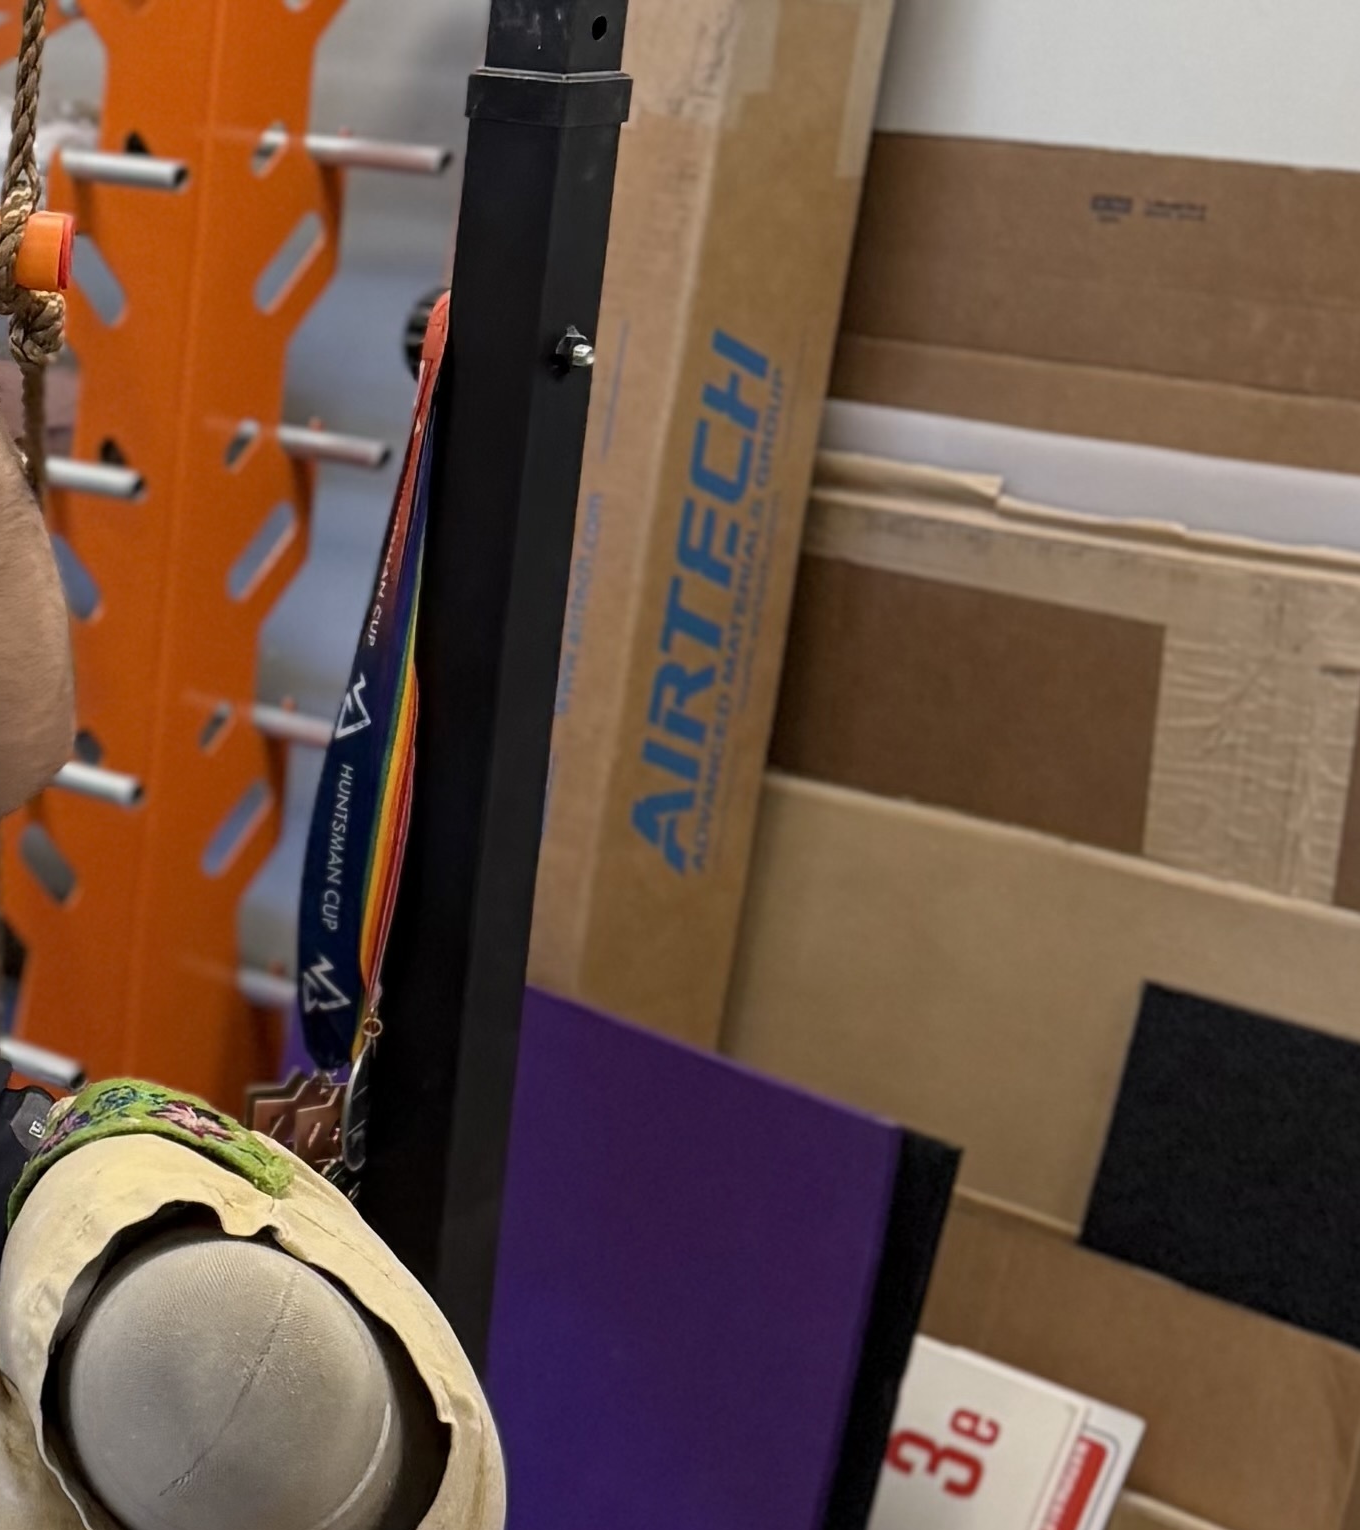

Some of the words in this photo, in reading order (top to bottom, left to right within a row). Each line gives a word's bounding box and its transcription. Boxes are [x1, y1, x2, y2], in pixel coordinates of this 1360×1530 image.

[630, 328, 770, 876] AIRTECH
[326, 763, 355, 886] HUNTSMAN
[321, 888, 342, 932] CUP
